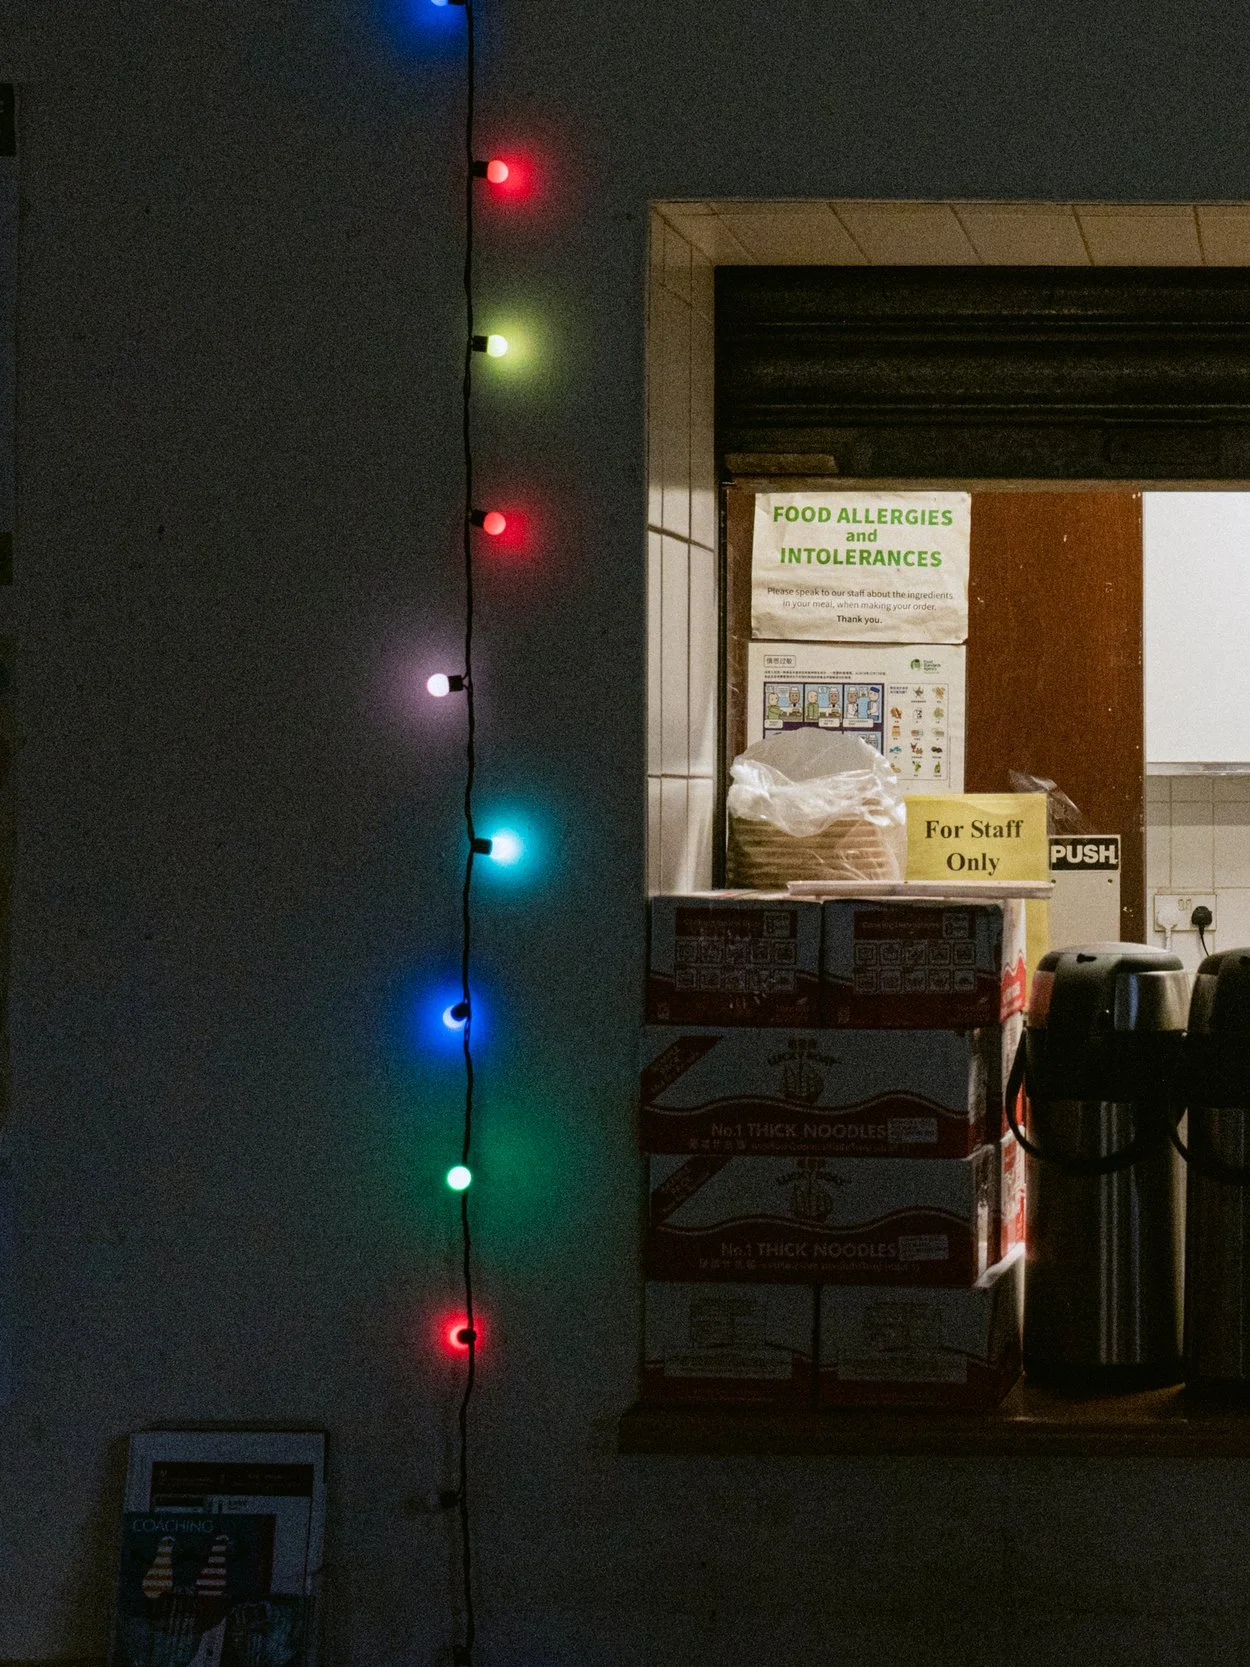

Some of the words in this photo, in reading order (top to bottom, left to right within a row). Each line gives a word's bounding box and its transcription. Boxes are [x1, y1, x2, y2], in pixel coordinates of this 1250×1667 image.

[773, 506, 832, 523] FOOD
[837, 507, 954, 526] ALLERGIES
[846, 529, 878, 542] and
[779, 547, 943, 568] INTOLERANCES
[767, 587, 794, 596] Please
[796, 588, 820, 599] speak
[821, 589, 830, 597] to
[847, 588, 865, 598] staff
[867, 589, 891, 599] about
[892, 590, 906, 599] the
[907, 591, 953, 602] ingredients
[783, 600, 790, 608] in
[791, 601, 811, 611] your
[813, 600, 835, 610] meal,
[837, 601, 859, 609] when
[860, 602, 891, 612] making
[892, 603, 912, 612] your
[912, 603, 937, 612] order.
[837, 615, 862, 624] Thank
[864, 616, 883, 626] you.
[925, 820, 964, 839] For
[970, 819, 1024, 839] Staff
[1051, 844, 1117, 865] PUSH
[946, 852, 1000, 876] Only
[711, 1123, 743, 1137] No.1
[748, 1123, 797, 1138] THICK
[803, 1124, 887, 1139] NOODLES
[721, 1242, 753, 1256] No.1
[757, 1242, 807, 1257] THICK
[814, 1242, 898, 1258] NOODLES
[132, 1518, 214, 1533] COACHING
